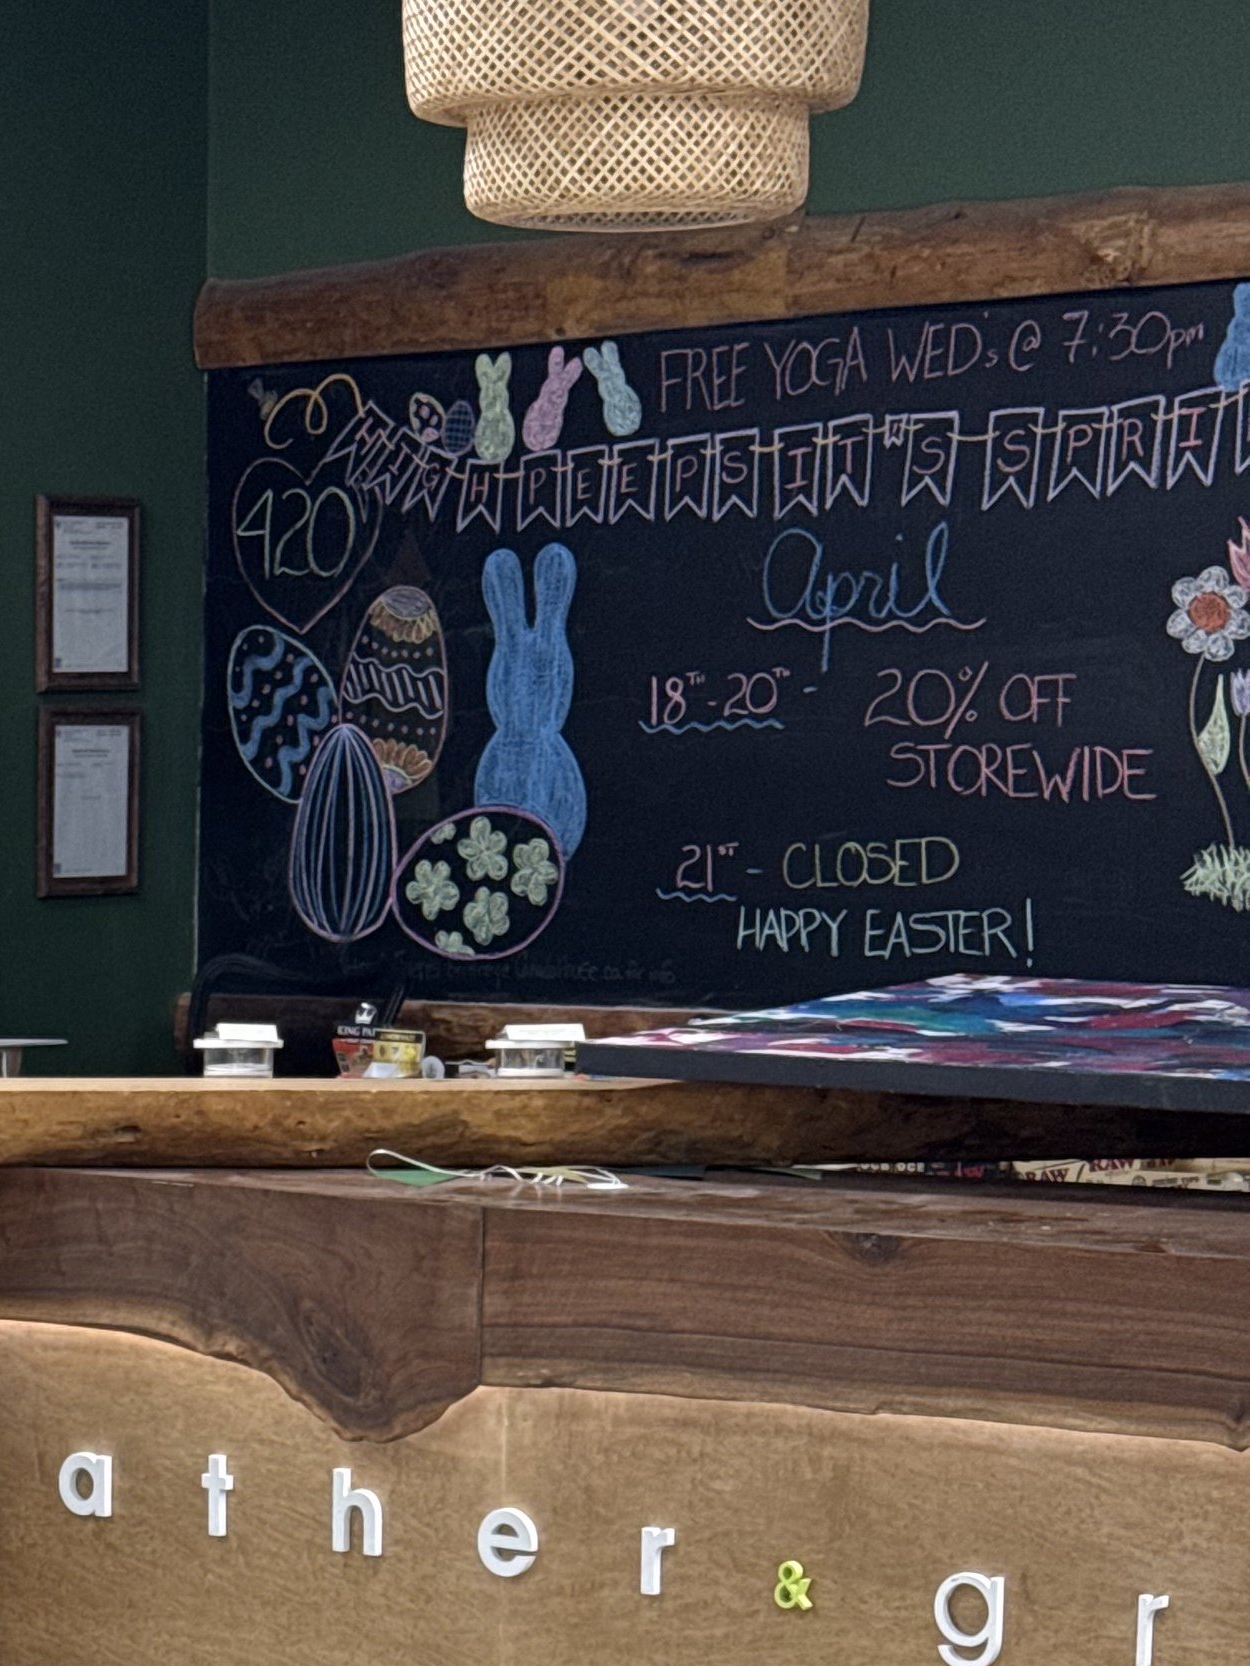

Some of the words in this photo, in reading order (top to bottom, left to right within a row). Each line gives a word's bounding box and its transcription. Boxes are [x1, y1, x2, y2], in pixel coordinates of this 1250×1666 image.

[660, 338, 749, 412] FREE
[765, 325, 868, 401] YOGA
[1008, 319, 1041, 373] @
[1062, 308, 1205, 370] 7:30pm
[529, 447, 749, 506] PEEPS
[996, 406, 1208, 474] SPRI
[236, 486, 356, 581] 420
[761, 520, 952, 673] April
[863, 660, 990, 740] 20%
[999, 672, 1078, 728] OFF
[885, 742, 1159, 804] STOREWIDE
[781, 835, 961, 891] CLOSED
[735, 904, 849, 961] HAPPY
[863, 897, 1036, 968] EASTER!
[773, 1560, 813, 1611] &
